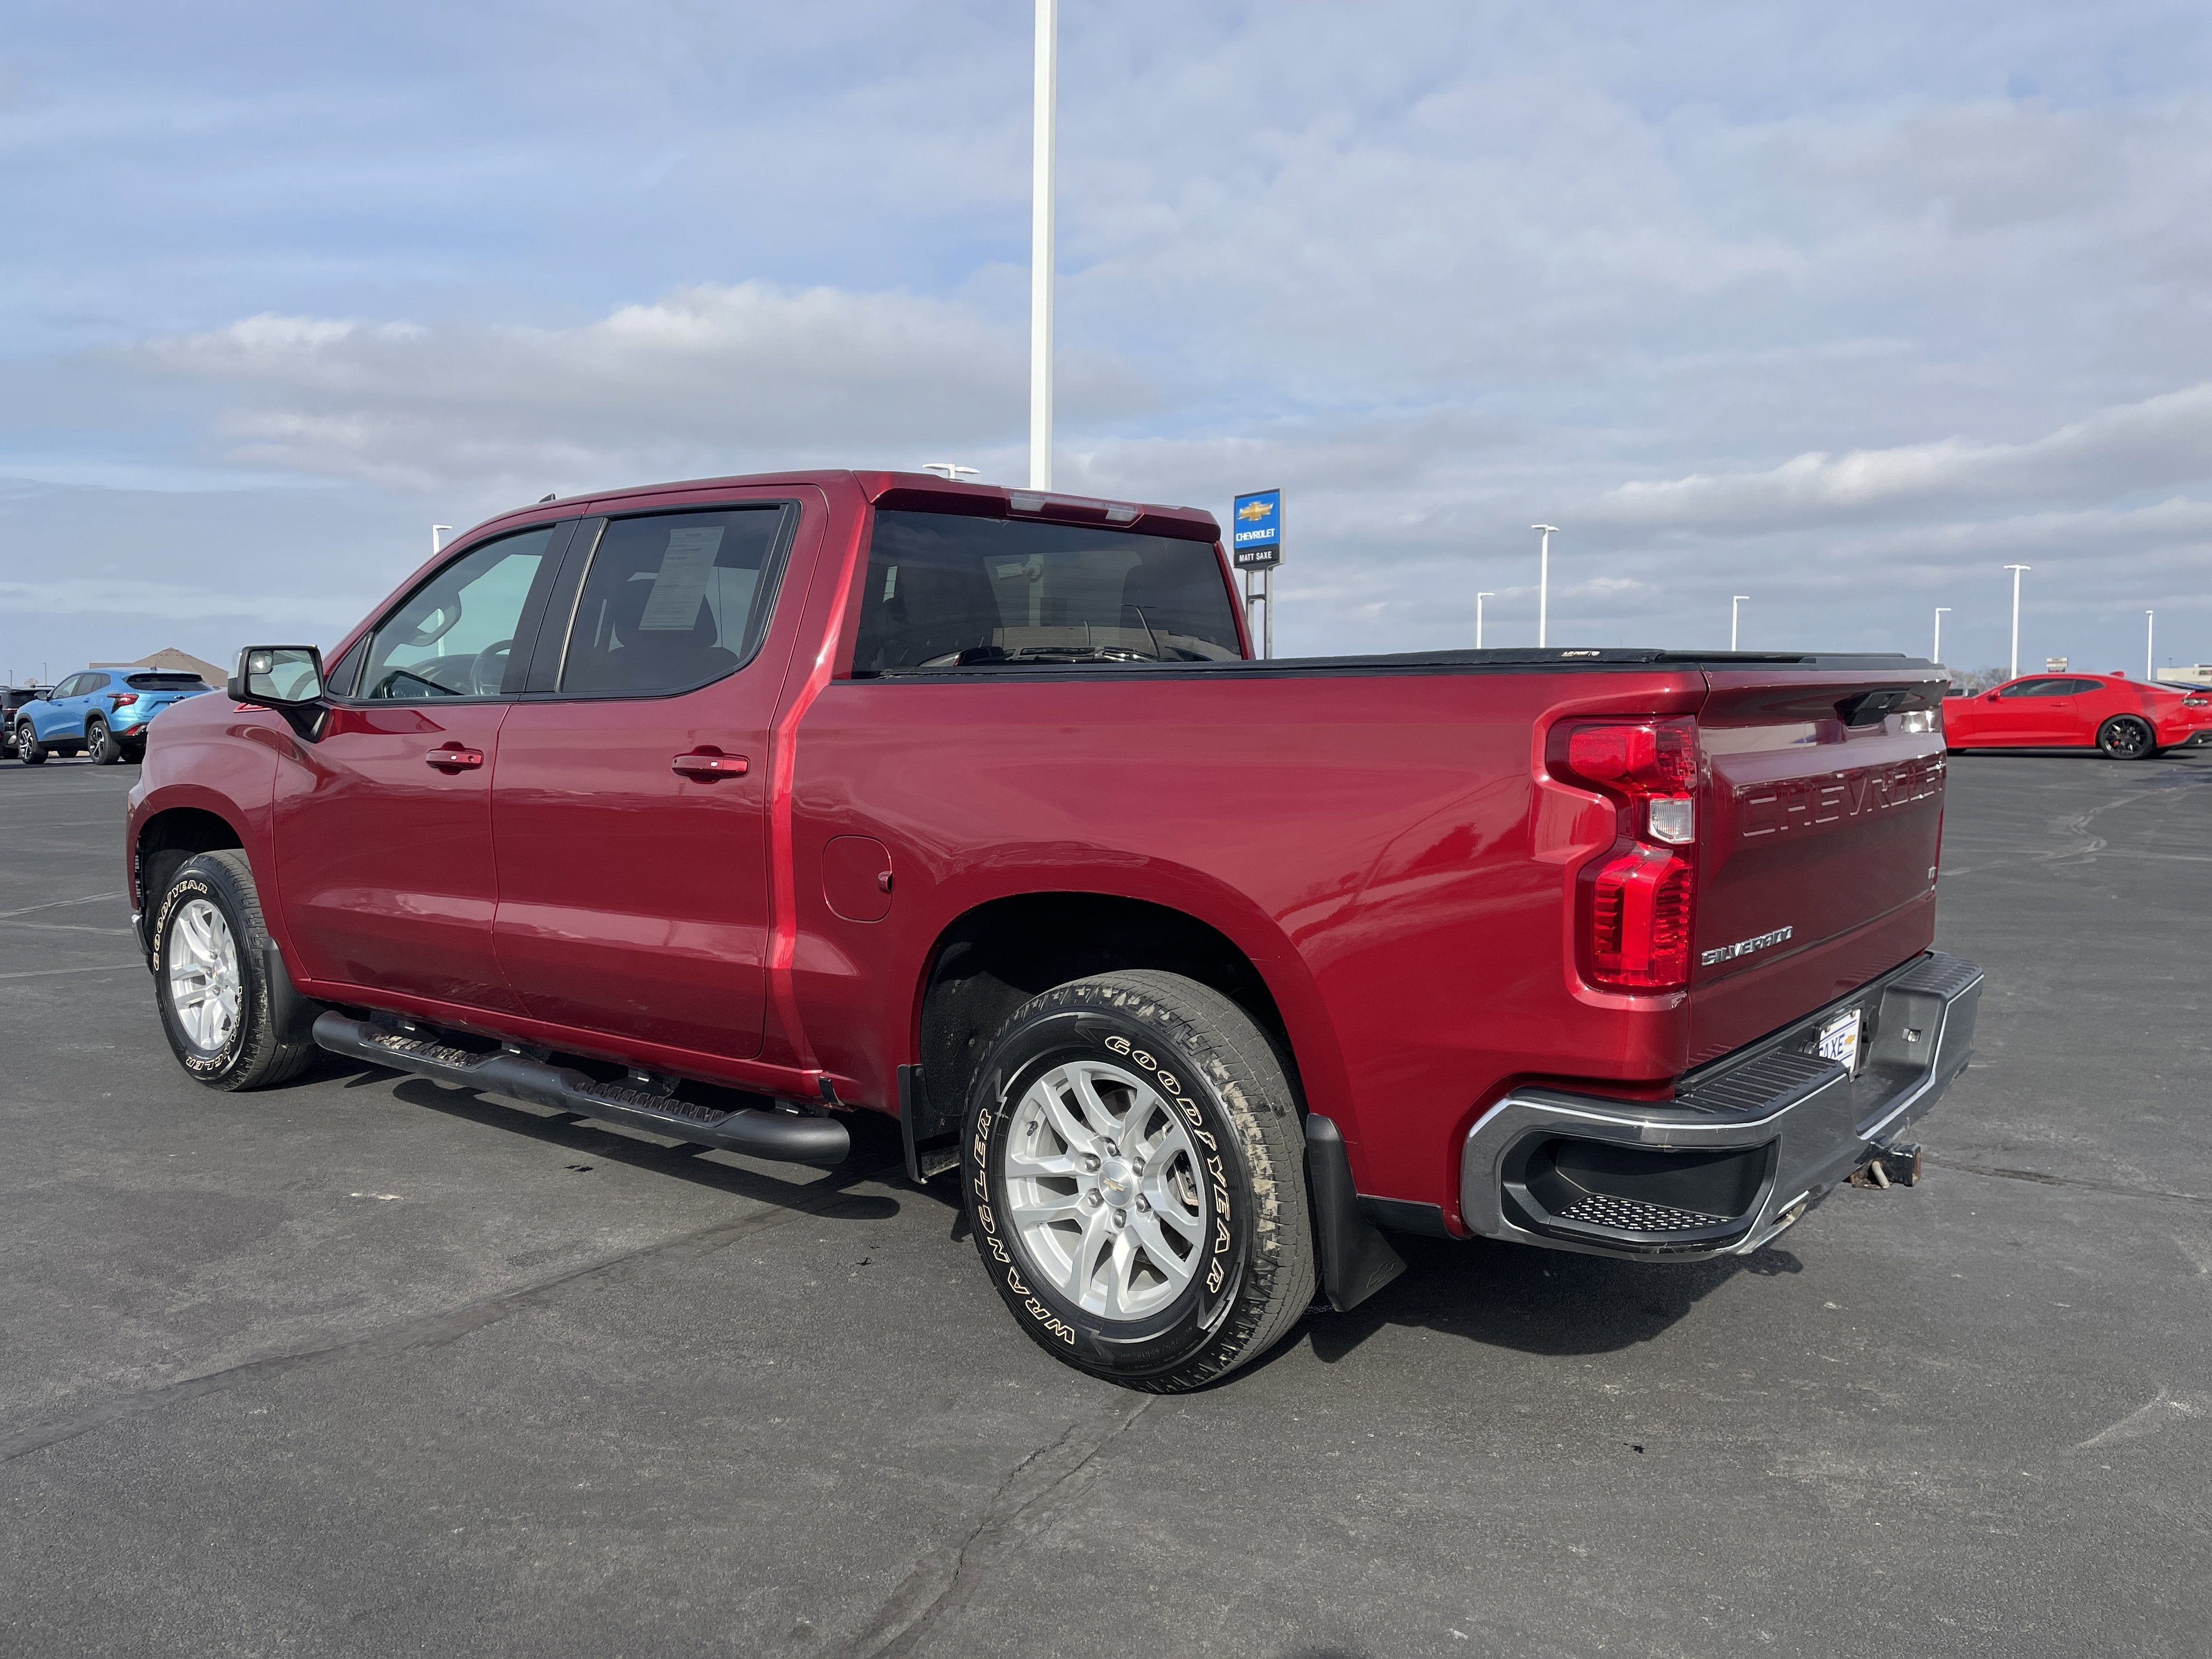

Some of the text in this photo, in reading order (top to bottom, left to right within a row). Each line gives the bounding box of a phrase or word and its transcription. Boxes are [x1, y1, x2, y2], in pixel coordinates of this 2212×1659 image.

[1236, 528, 1276, 541] CHEVROLET
[1239, 551, 1272, 562] MATT SAXE
[153, 879, 208, 971] GOODYEAR
[1701, 926, 1793, 967] SILVERADO
[1104, 1035, 1232, 1294] GOODYEAR
[974, 1108, 1076, 1345] WRANGLER
